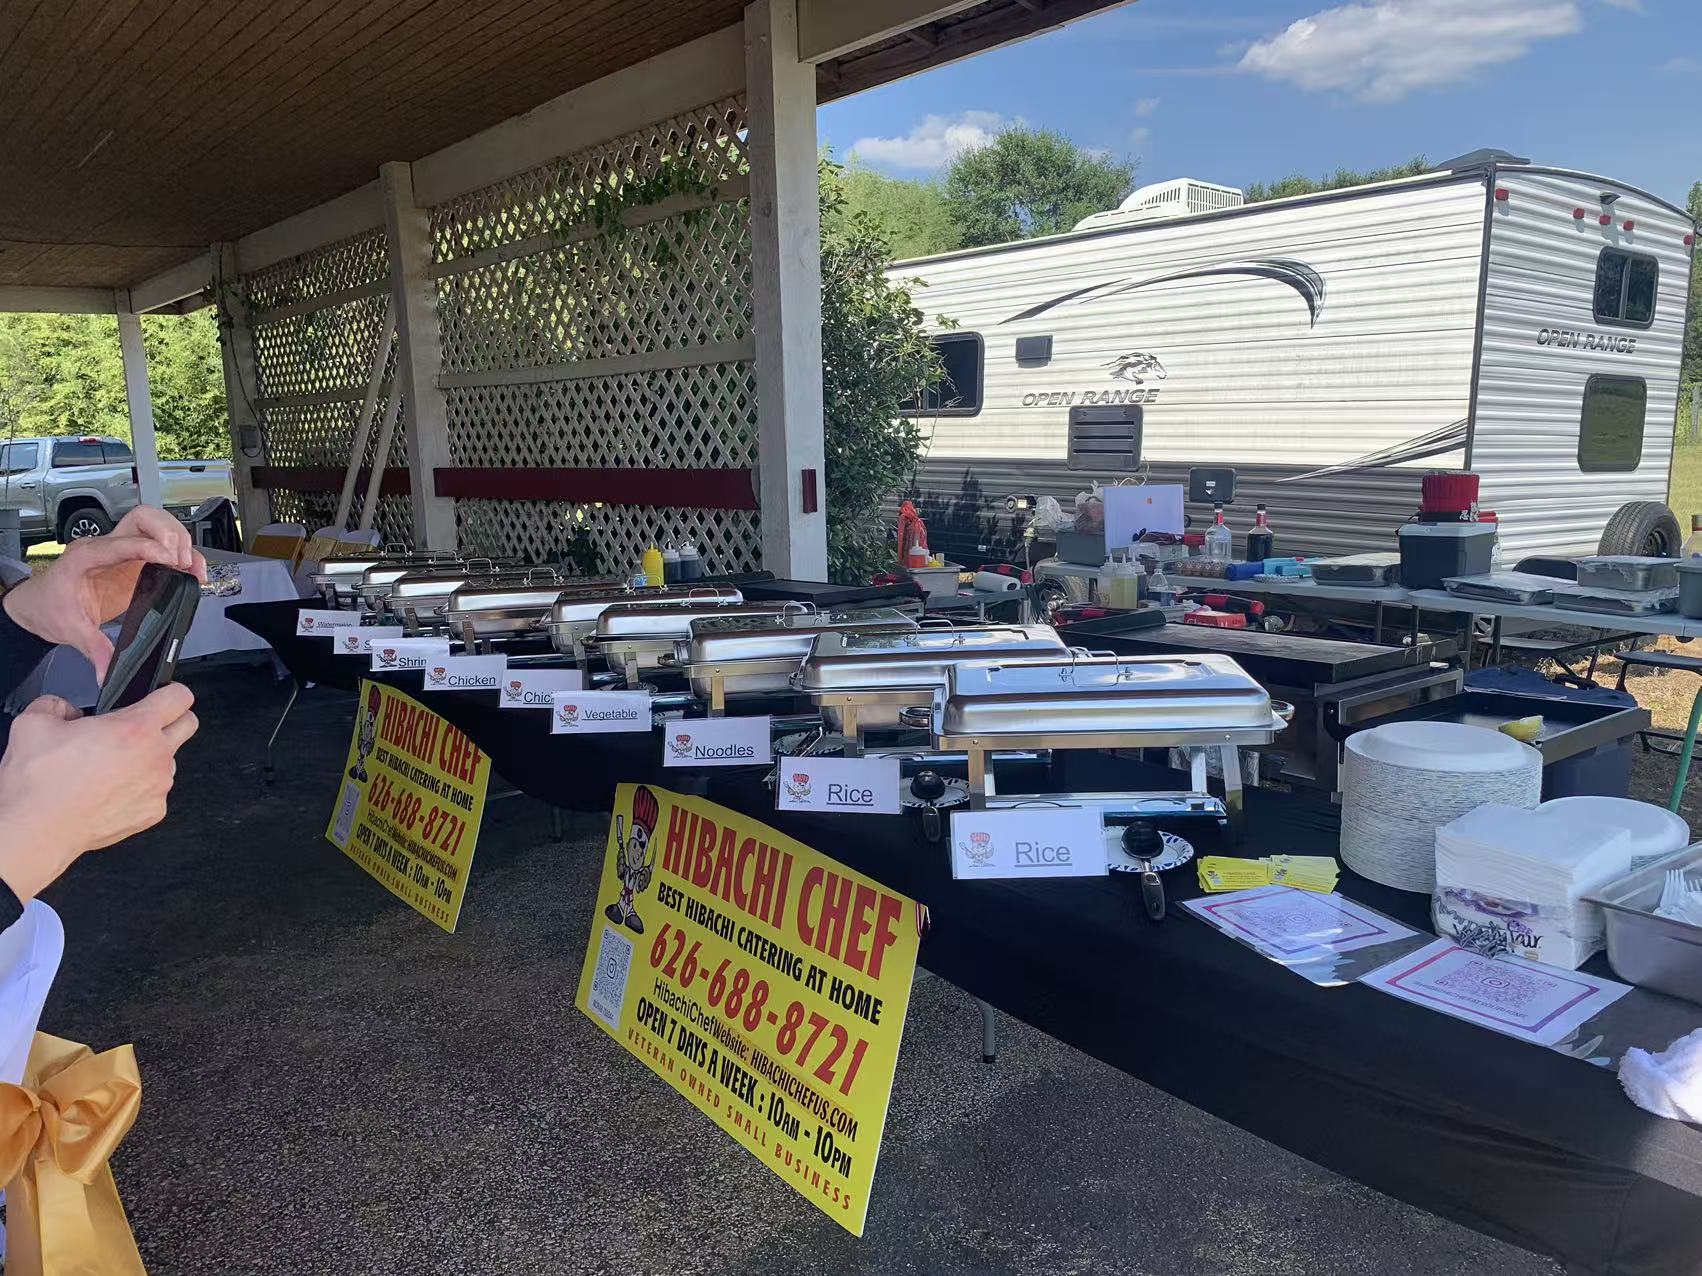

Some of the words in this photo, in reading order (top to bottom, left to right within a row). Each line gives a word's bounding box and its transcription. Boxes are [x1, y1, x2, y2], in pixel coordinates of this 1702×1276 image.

[1537, 328, 1581, 349] OPEN
[1583, 334, 1637, 354] RANGE
[1022, 391, 1076, 406] OPEN
[1080, 388, 1160, 405] RANGE
[448, 675, 497, 687] Chicken
[523, 691, 554, 703] Chic
[380, 695, 441, 765] HIBACHI
[438, 723, 482, 785] CHEF
[584, 708, 638, 720] Vegetable
[375, 746, 389, 765] BEST
[410, 766, 441, 796] CATERING
[440, 782, 452, 800] AT
[451, 787, 474, 812] HOME
[694, 743, 755, 758] Noodles
[368, 772, 466, 857] 626-688-8721
[827, 782, 874, 804] Rice
[391, 848, 411, 877] WEEK
[412, 863, 431, 890] 10AM
[434, 876, 453, 905] 10PM
[1014, 841, 1072, 864] Rice
[661, 804, 794, 931] HIBACHI
[796, 866, 903, 981] CHEF
[657, 881, 685, 914] BEST
[685, 896, 736, 943] HIBACHI
[737, 926, 803, 982] CATERING
[804, 965, 828, 995] AT
[829, 978, 883, 1026] HOME
[650, 922, 869, 1097] 626-688-8721
[636, 996, 668, 1041] OPEN
[667, 1020, 677, 1044] 7
[677, 1025, 706, 1069] DAYS
[707, 1049, 718, 1079] A
[719, 1055, 759, 1107] WEEK
[767, 1091, 801, 1142] 10AM
[813, 1124, 853, 1179] 10PM
[750, 1049, 859, 1143] HIBACHICHEFUS.COM
[627, 1027, 675, 1073] VETERAN
[680, 1068, 721, 1108] OWNED
[726, 1105, 767, 1148] SMALL
[774, 1142, 851, 1211] BUSINESS
